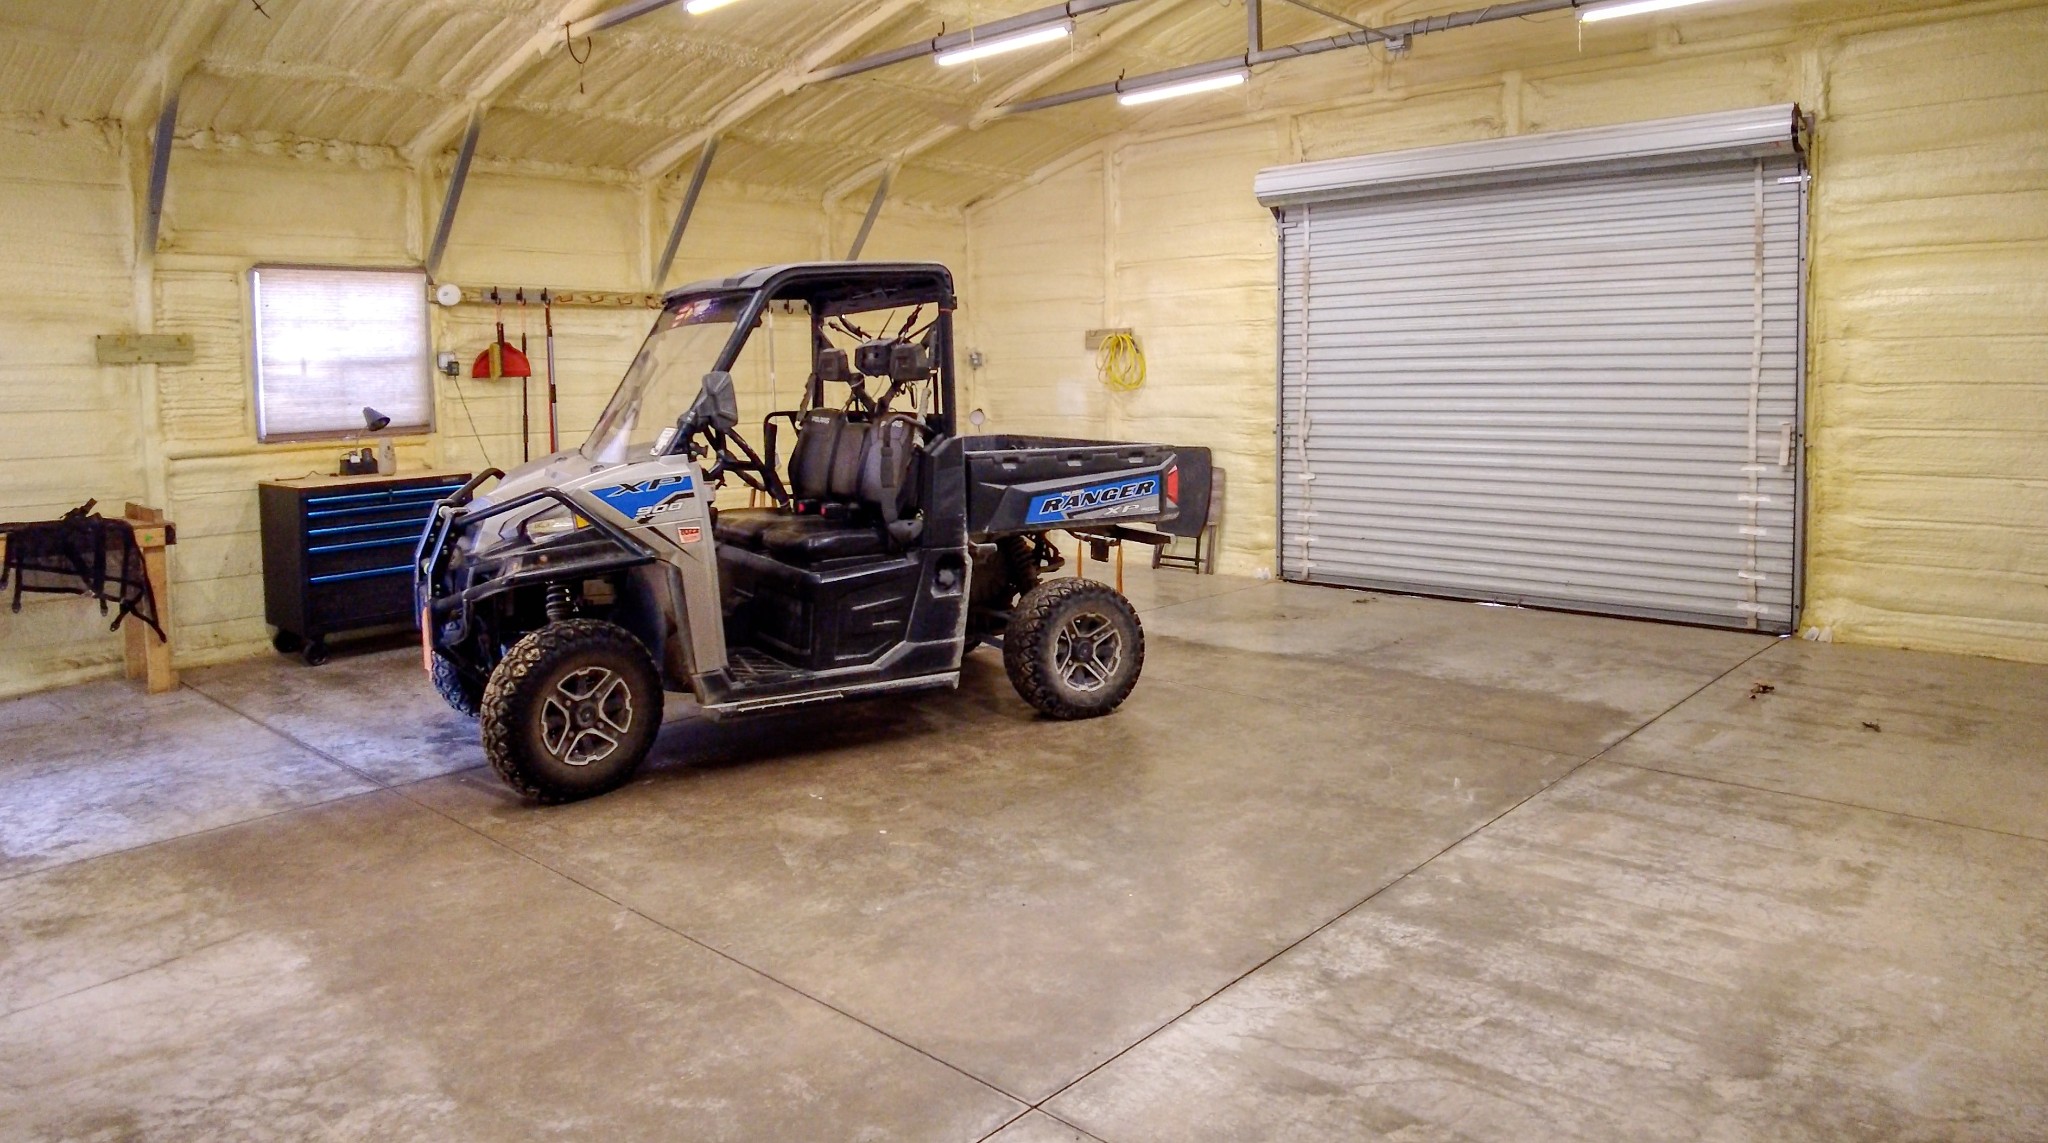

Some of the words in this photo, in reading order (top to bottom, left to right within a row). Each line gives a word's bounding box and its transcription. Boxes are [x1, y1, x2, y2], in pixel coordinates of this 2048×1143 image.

[608, 476, 684, 497] XP
[1039, 481, 1155, 514] RANGER
[636, 502, 683, 516] 900
[1104, 504, 1140, 515] XP
